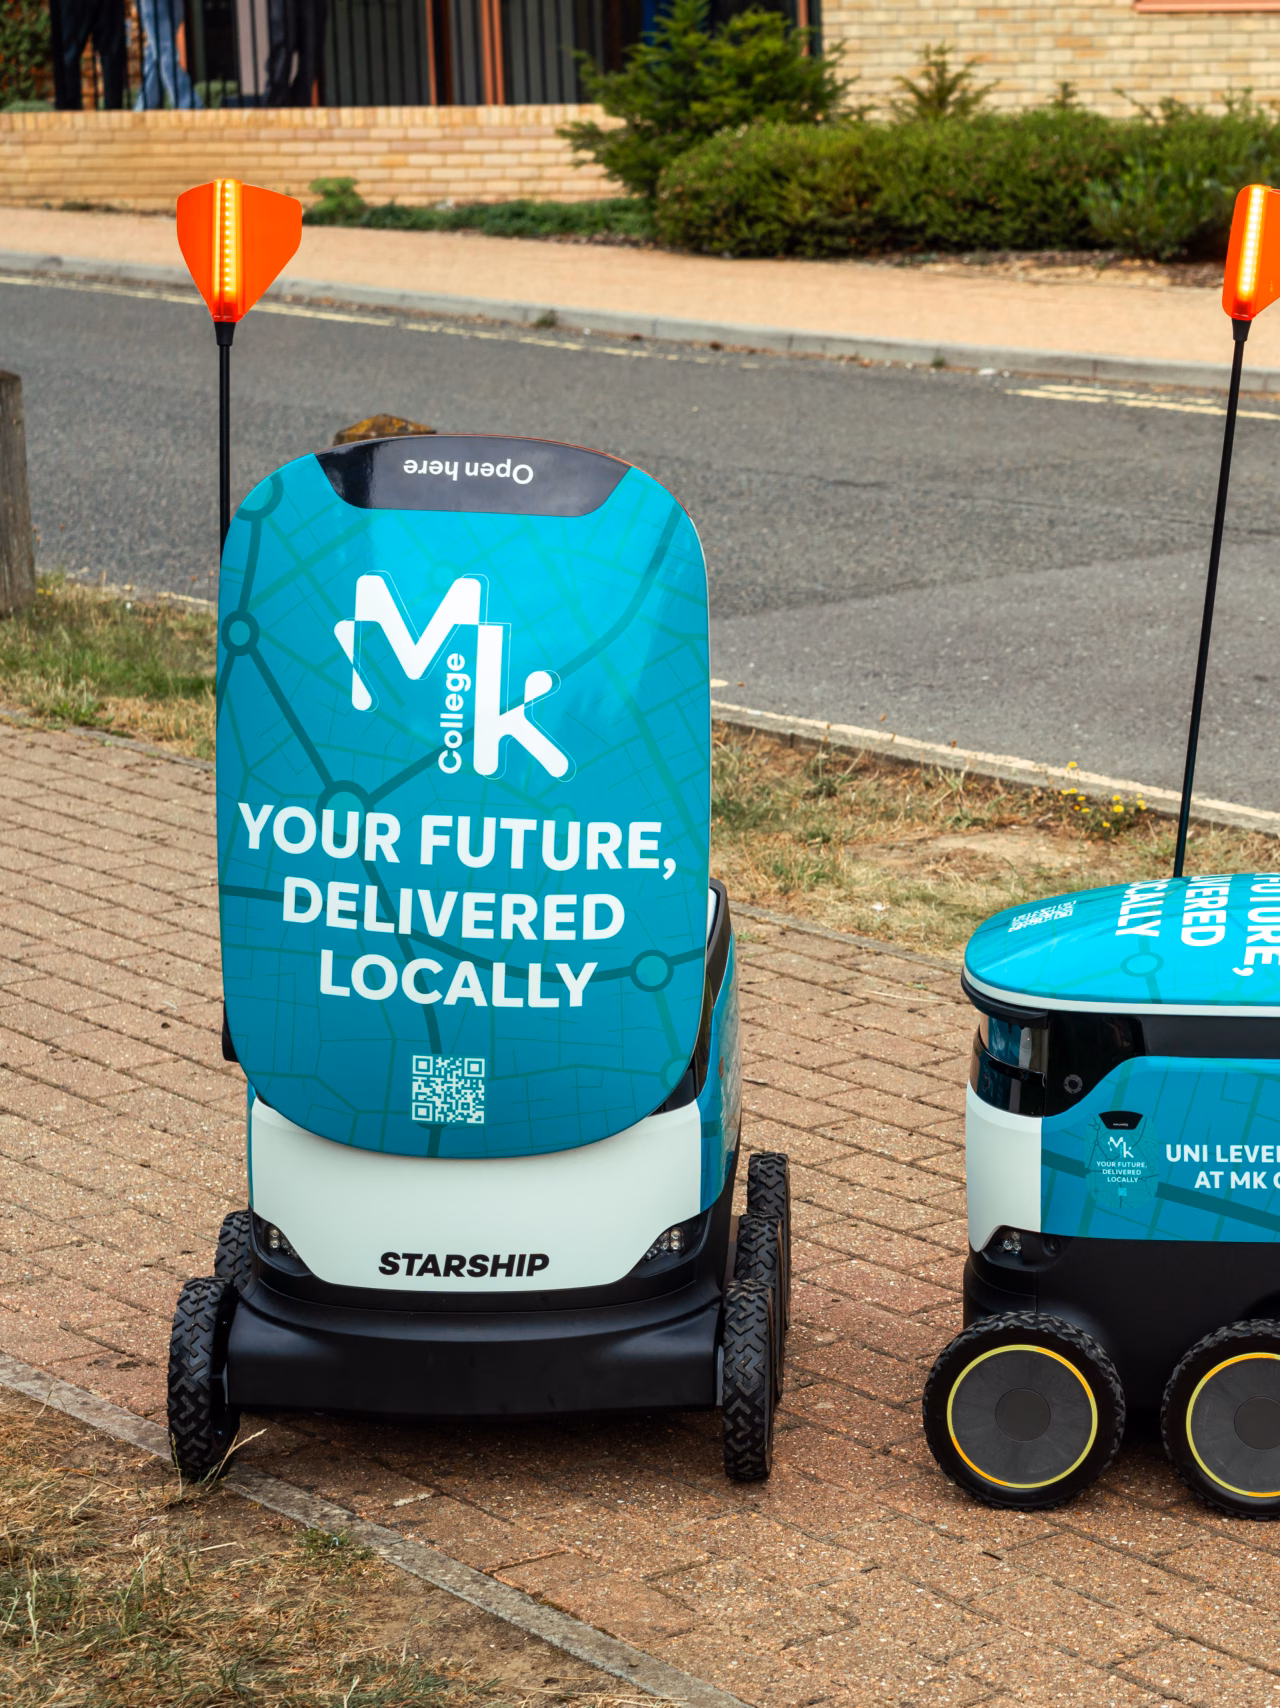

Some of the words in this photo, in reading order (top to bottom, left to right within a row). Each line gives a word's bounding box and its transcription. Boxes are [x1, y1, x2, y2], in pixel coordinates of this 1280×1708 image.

[403, 459, 459, 482] here
[465, 458, 534, 485] Open
[439, 653, 471, 774] College
[238, 802, 401, 864] YOUR
[420, 814, 677, 881] FUTURE,
[283, 876, 626, 941] DELIVERED
[320, 949, 599, 1008] LOCALLY
[1096, 1160, 1116, 1168] YOUR
[1117, 1161, 1148, 1169] FUTURE,
[1166, 1144, 1208, 1164] UNI
[1102, 1168, 1142, 1176] DELIVERED
[1194, 1171, 1225, 1189] AT
[1230, 1171, 1267, 1189] MK
[378, 1251, 550, 1278] STARSHIP
